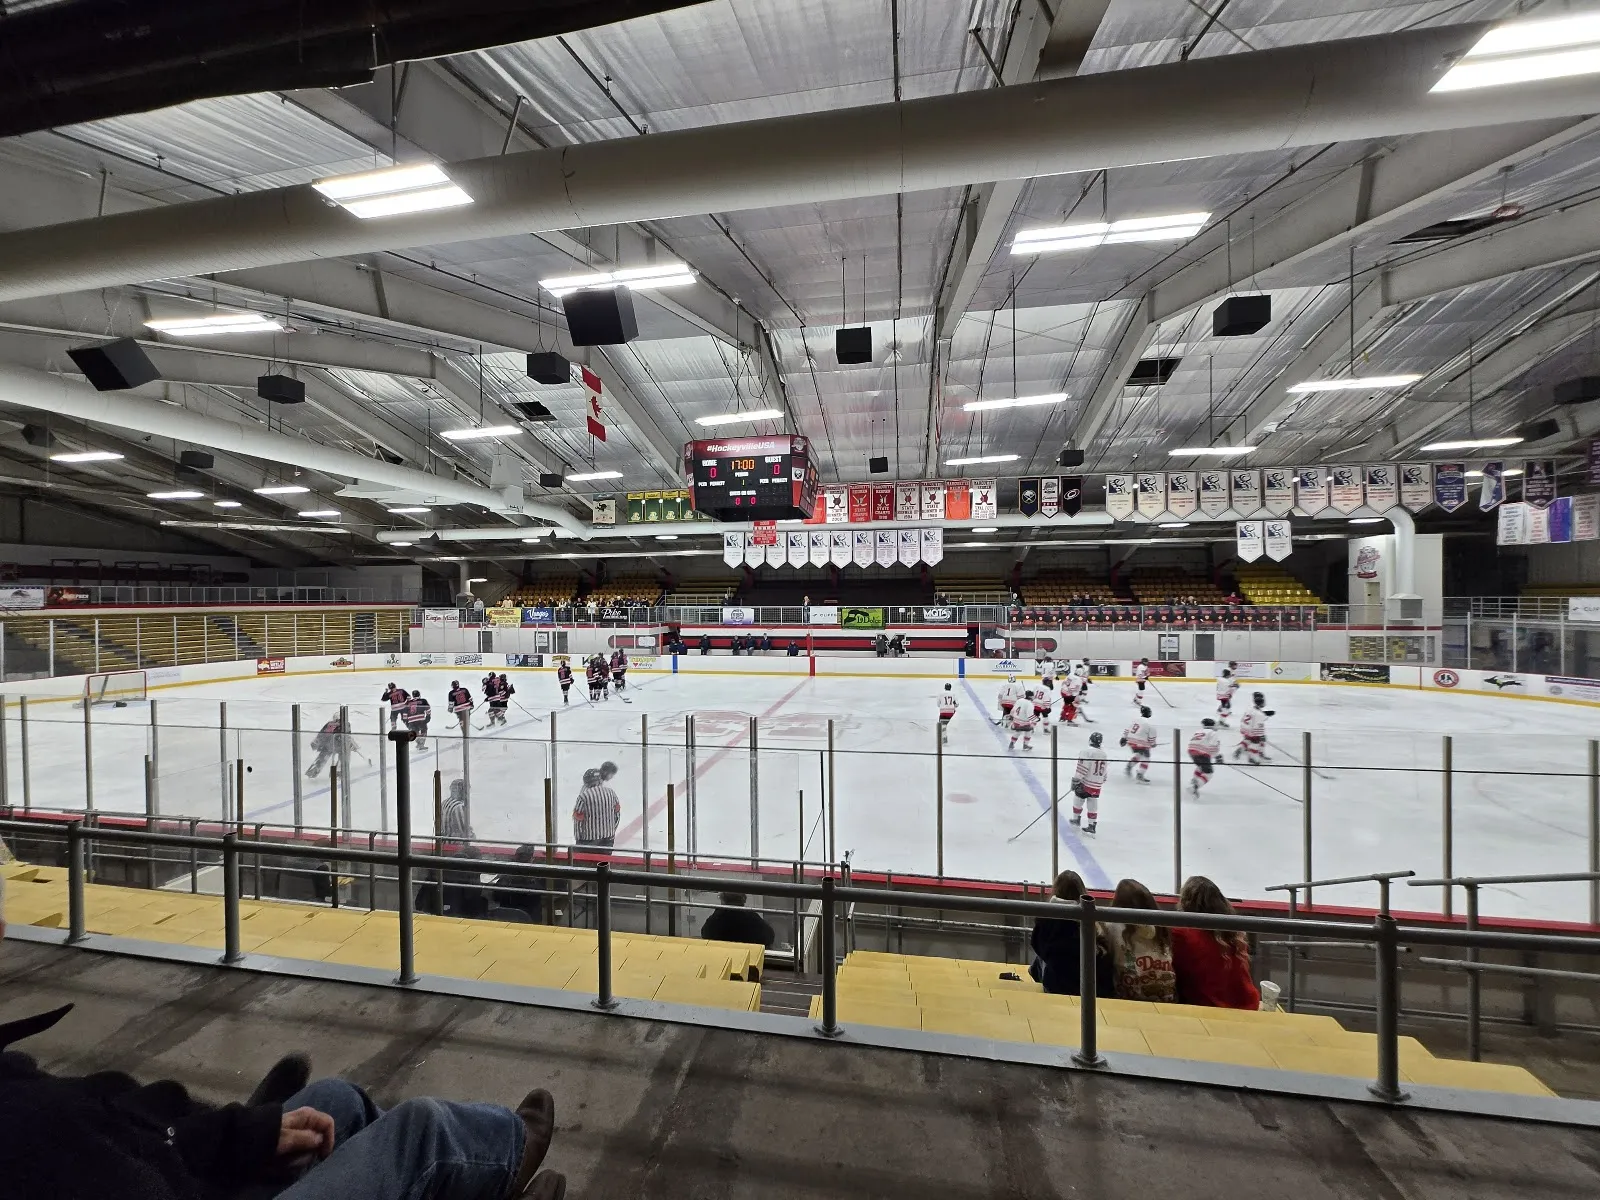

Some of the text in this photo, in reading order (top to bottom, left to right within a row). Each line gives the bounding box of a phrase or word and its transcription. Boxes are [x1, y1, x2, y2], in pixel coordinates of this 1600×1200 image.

[707, 441, 776, 453] #HockeyvilleUSA
[731, 459, 755, 470] 17:00
[773, 464, 780, 475] 0
[710, 467, 717, 479] 0
